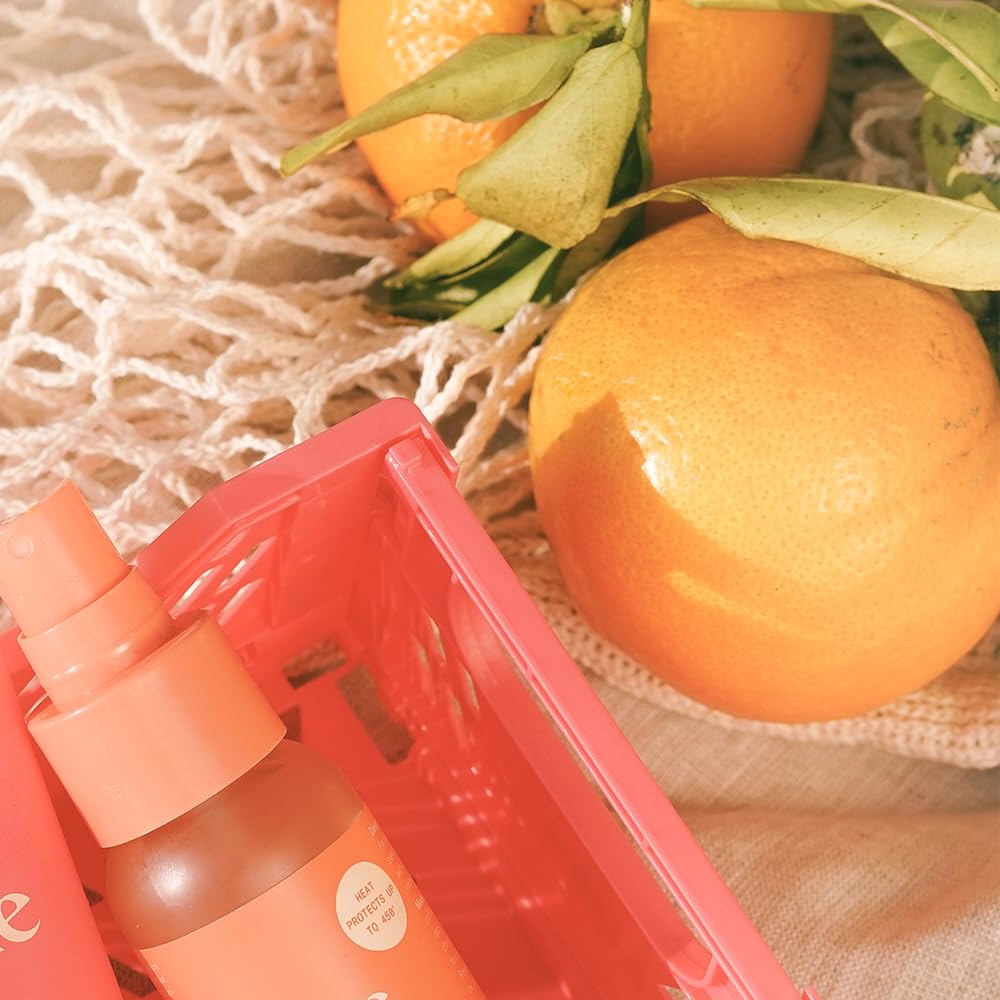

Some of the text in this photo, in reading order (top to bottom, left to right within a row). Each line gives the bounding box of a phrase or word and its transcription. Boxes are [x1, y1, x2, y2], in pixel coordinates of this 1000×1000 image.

[355, 881, 375, 902] HEAT
[346, 894, 386, 930] PROTECTS
[385, 884, 394, 897] UP
[366, 922, 378, 935] TO
